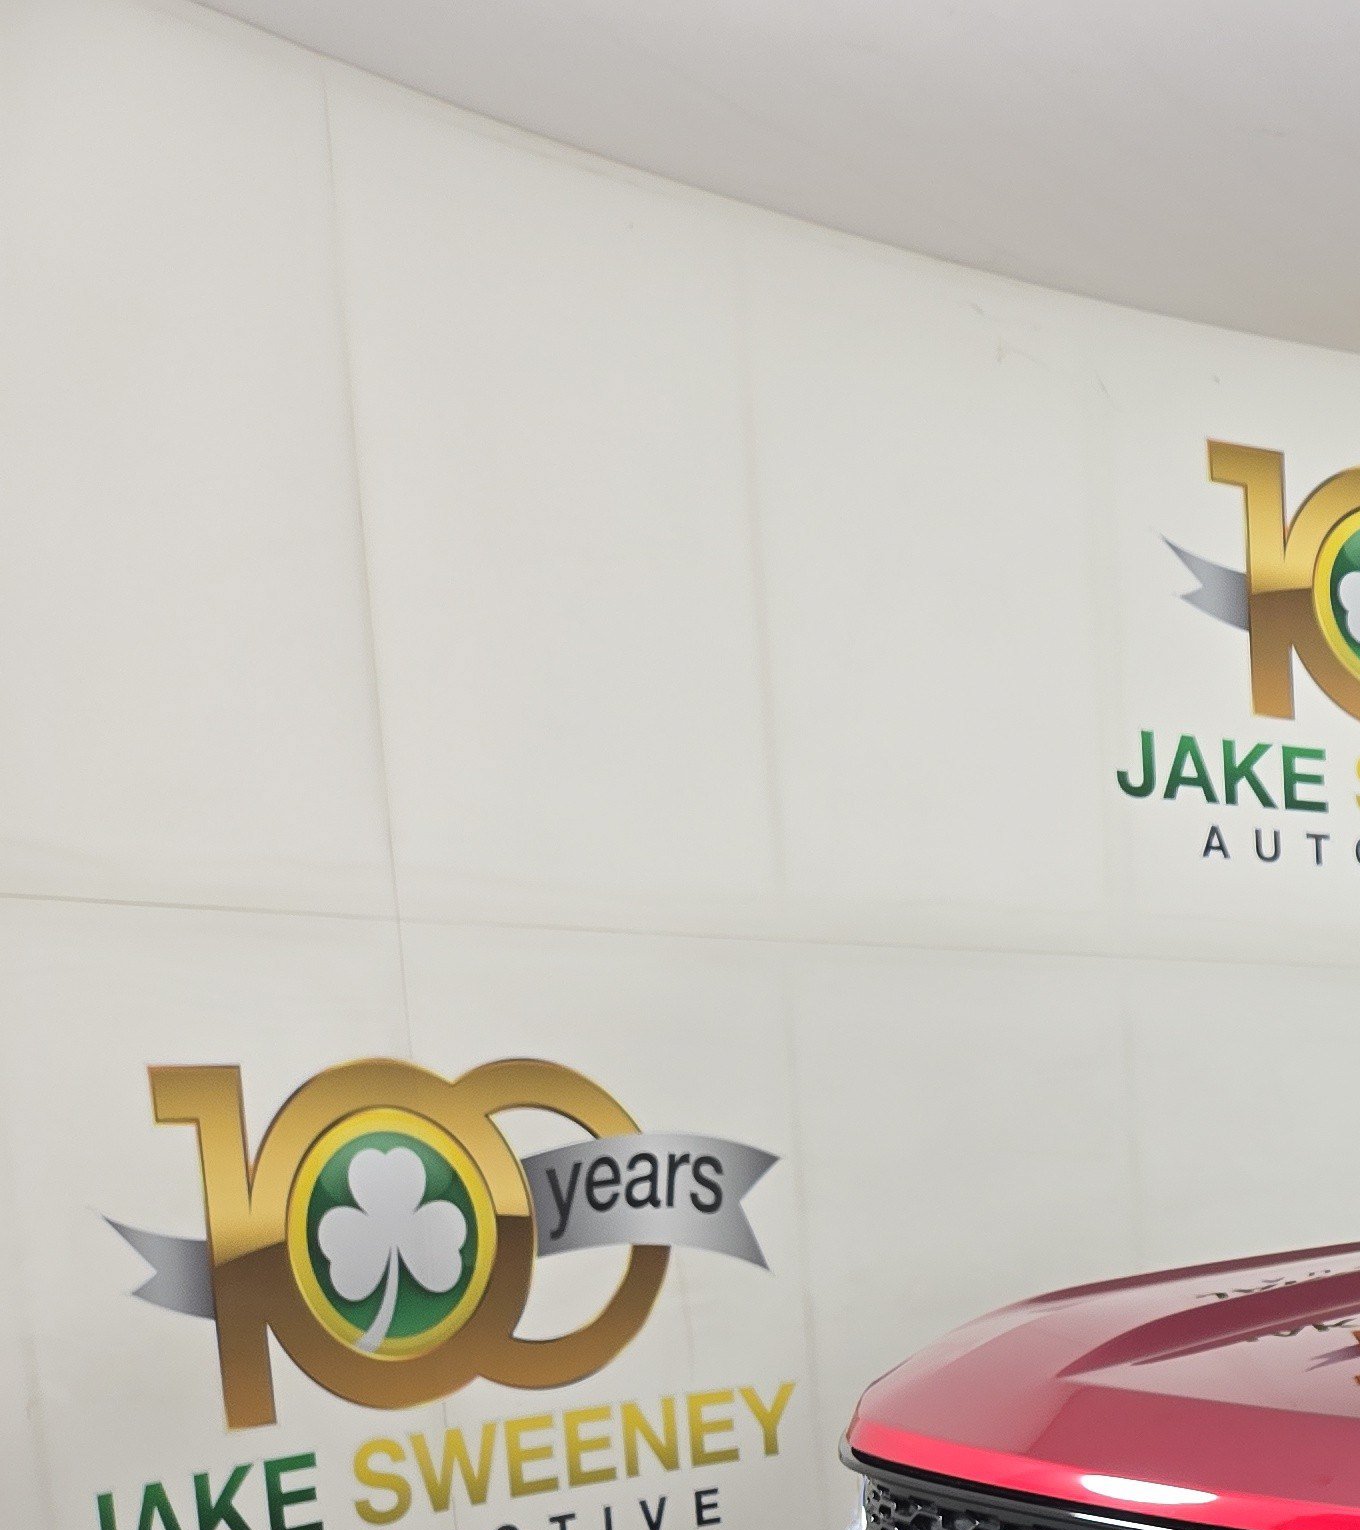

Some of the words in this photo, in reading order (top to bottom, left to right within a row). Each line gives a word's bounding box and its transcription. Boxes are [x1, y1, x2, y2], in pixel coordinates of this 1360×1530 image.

[1115, 729, 1330, 814] JAKE
[544, 1151, 725, 1240] years
[351, 1381, 798, 1527] SWEENEY
